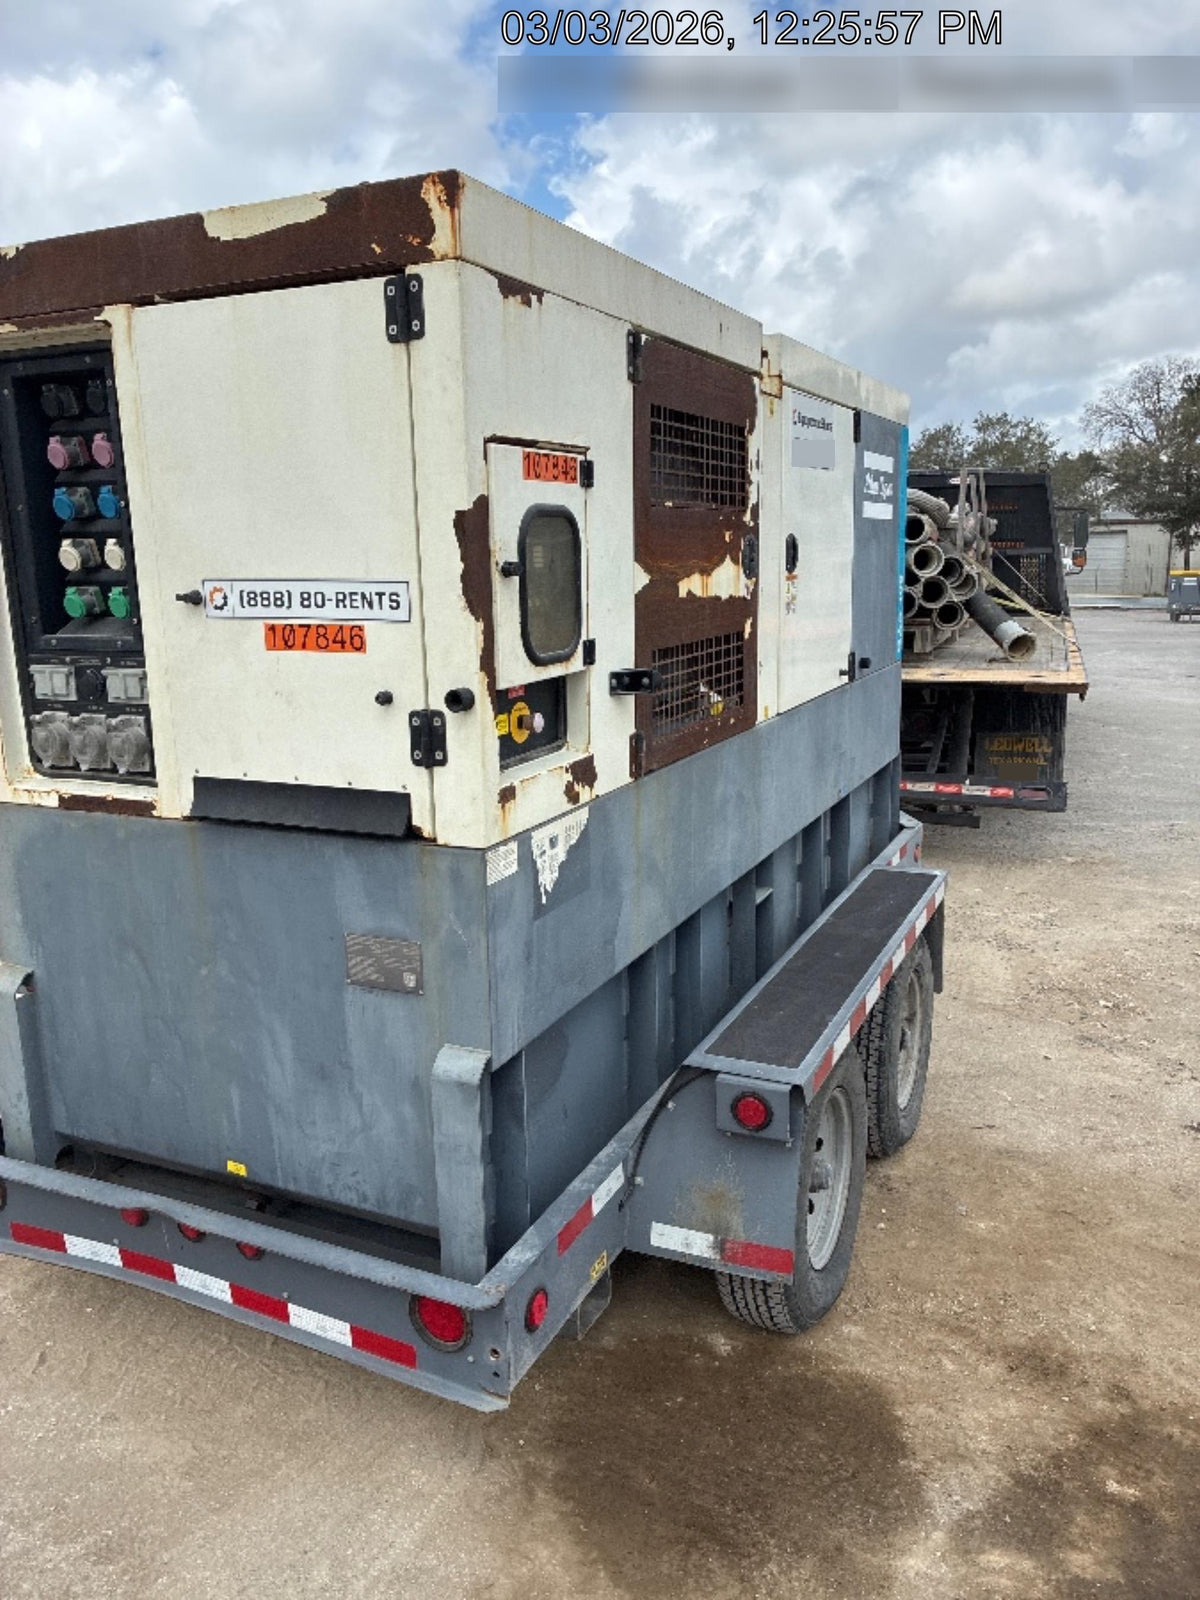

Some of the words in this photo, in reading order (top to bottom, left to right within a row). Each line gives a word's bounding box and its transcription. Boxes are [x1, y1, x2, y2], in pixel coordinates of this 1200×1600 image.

[239, 590, 292, 609] (888)
[300, 591, 401, 610] 80-RENTS
[267, 624, 364, 650] 107846
